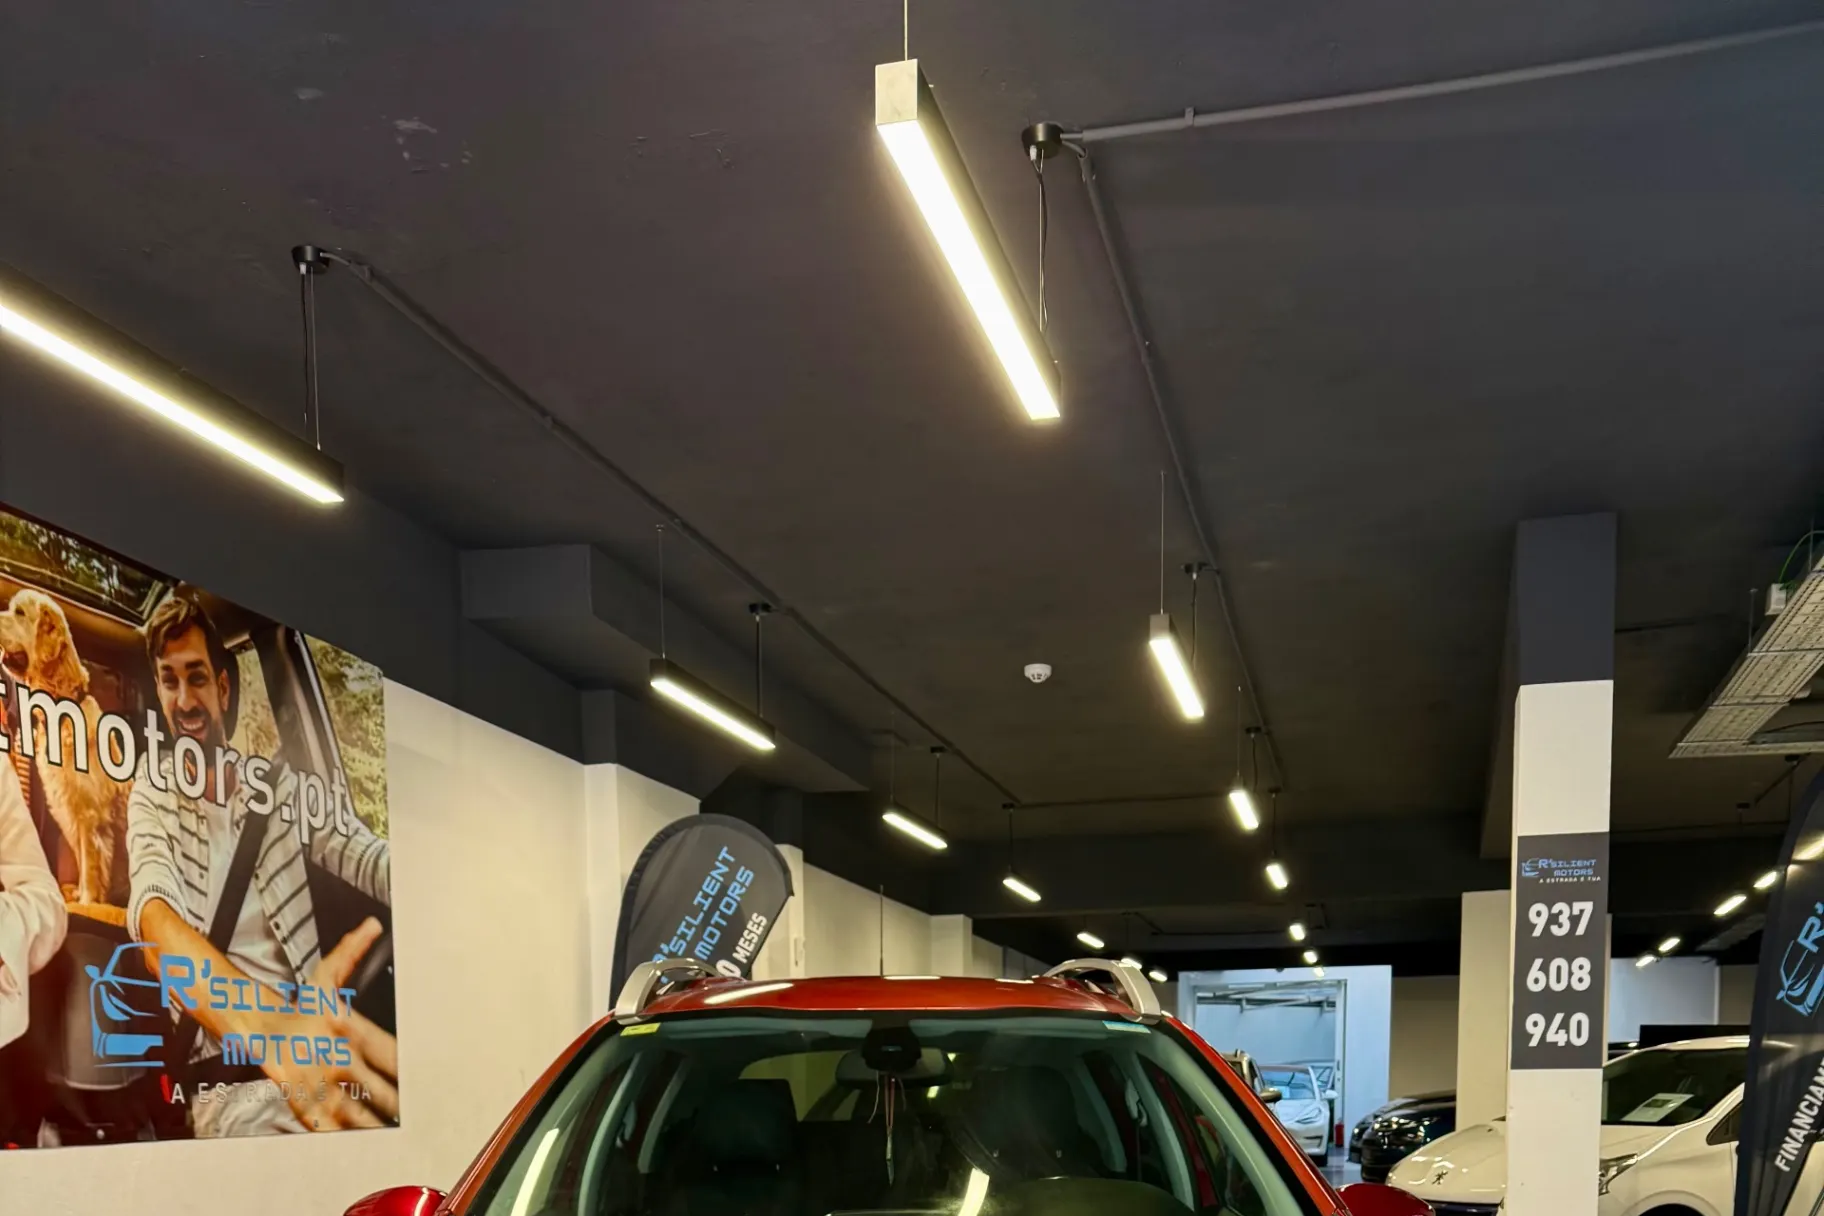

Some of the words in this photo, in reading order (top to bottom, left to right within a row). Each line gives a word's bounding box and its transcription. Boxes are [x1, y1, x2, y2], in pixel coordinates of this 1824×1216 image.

[1554, 868, 1594, 876] MOTORS
[694, 865, 755, 961] MOTORS
[1528, 901, 1593, 937] 937
[732, 911, 769, 964] MESES
[159, 954, 357, 1016] R'SILIENT
[1526, 957, 1592, 992] 608
[1525, 1012, 1590, 1047] 940
[222, 1032, 352, 1066] MOTORS
[170, 1083, 185, 1104] A
[197, 1081, 308, 1104] ESTRADA
[338, 1081, 372, 1101] TUA
